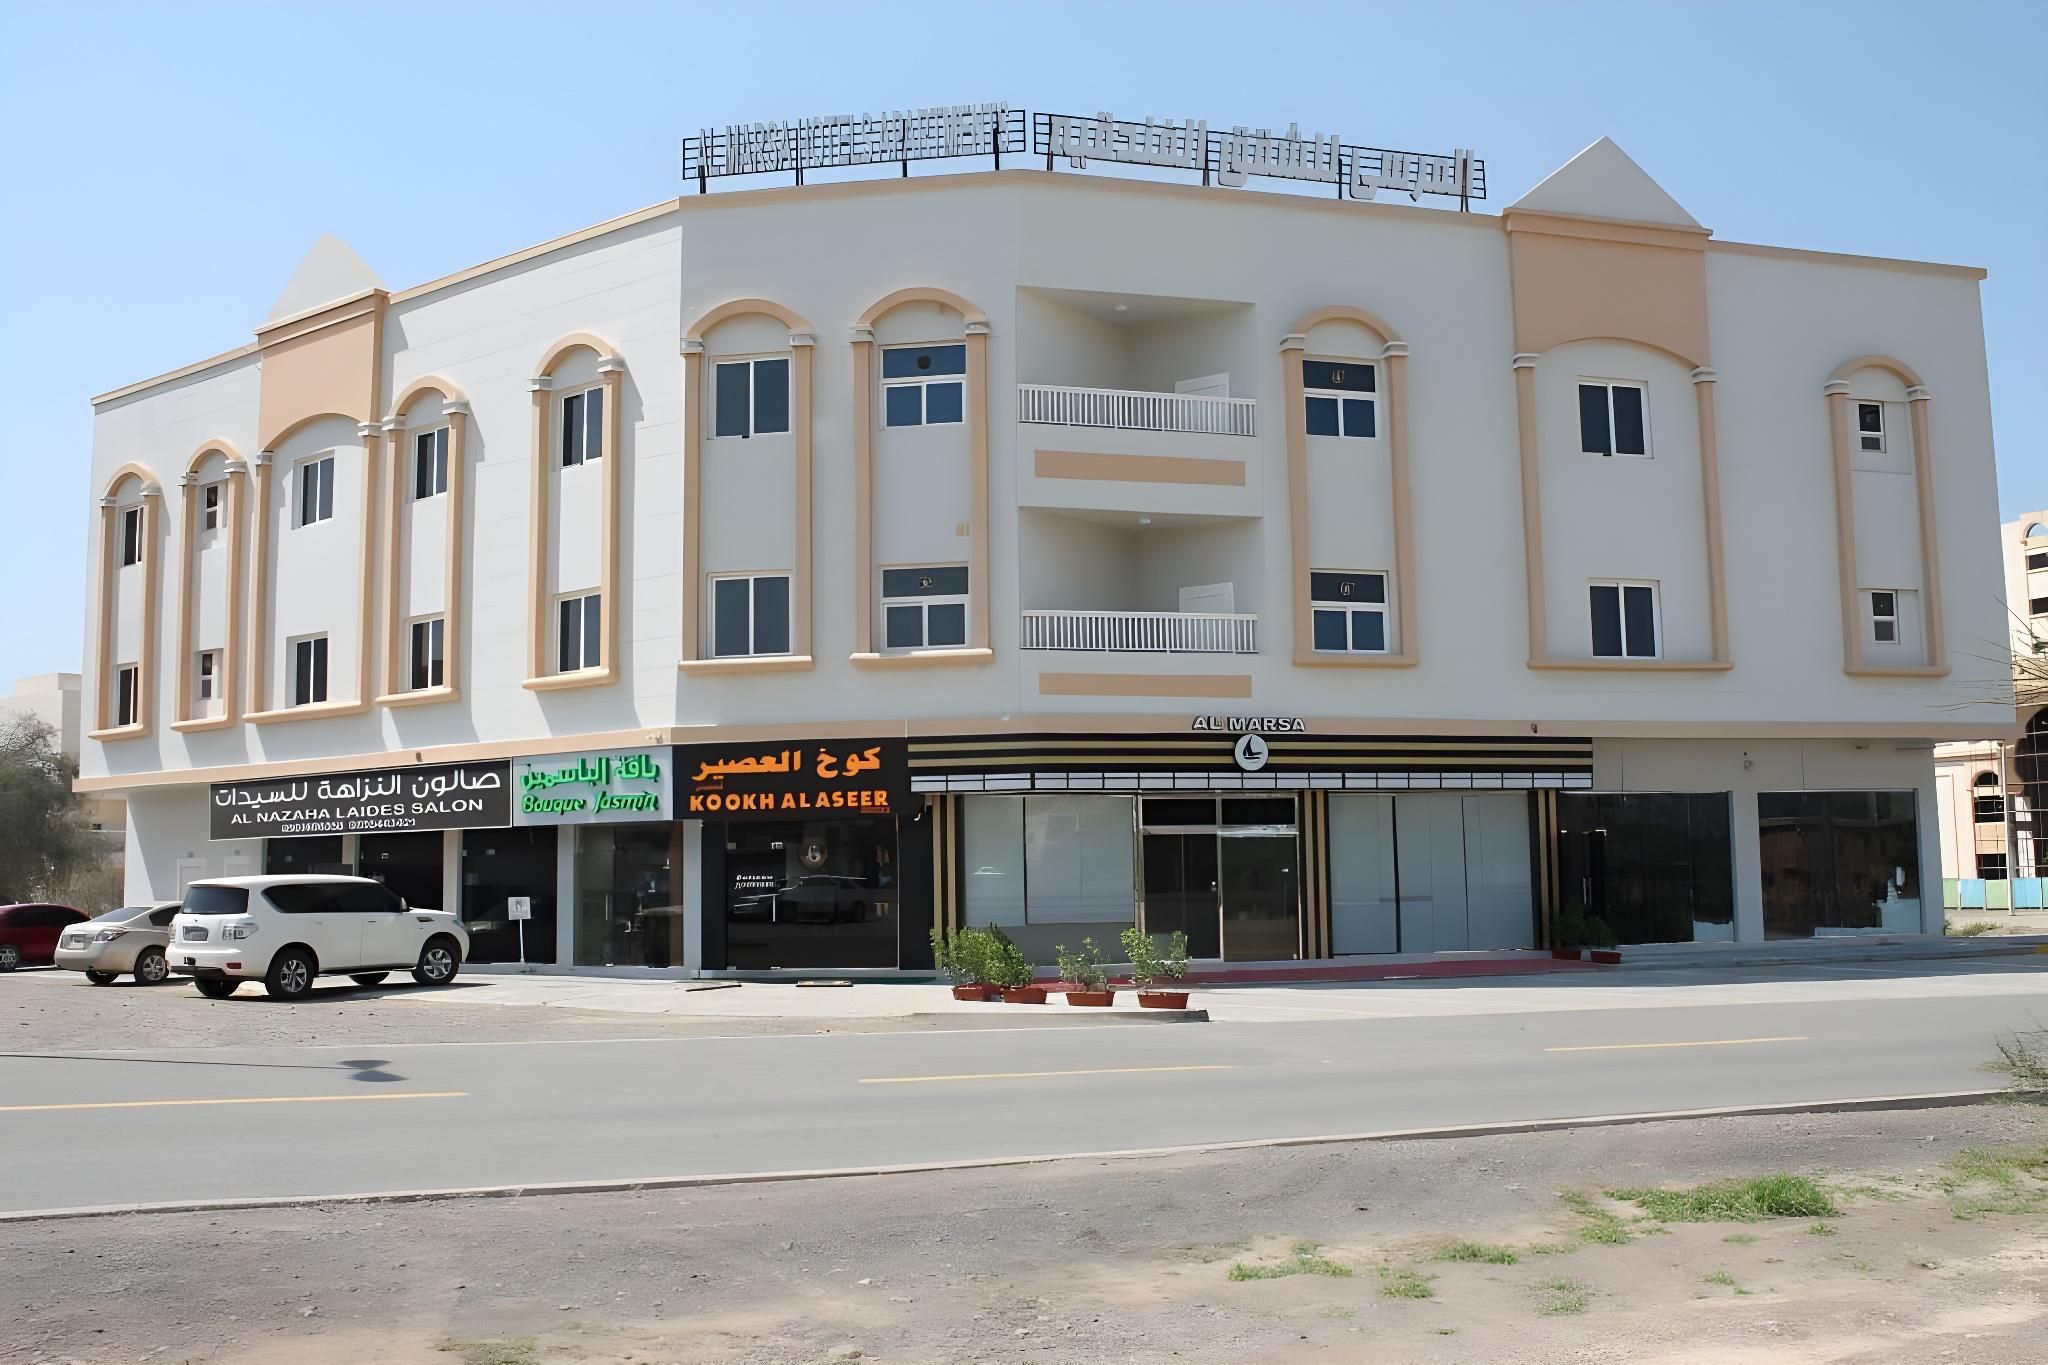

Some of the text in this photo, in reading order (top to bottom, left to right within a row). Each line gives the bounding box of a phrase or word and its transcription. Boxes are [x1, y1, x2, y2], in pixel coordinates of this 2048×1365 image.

[1192, 716, 1305, 732] AL MARSA
[691, 747, 881, 781] كوخ العصير
[215, 769, 500, 810] صالون النزاهة للسيدات
[690, 793, 775, 812] KOOKH
[231, 799, 483, 825] AL NAZAHA LAIDES SALON
